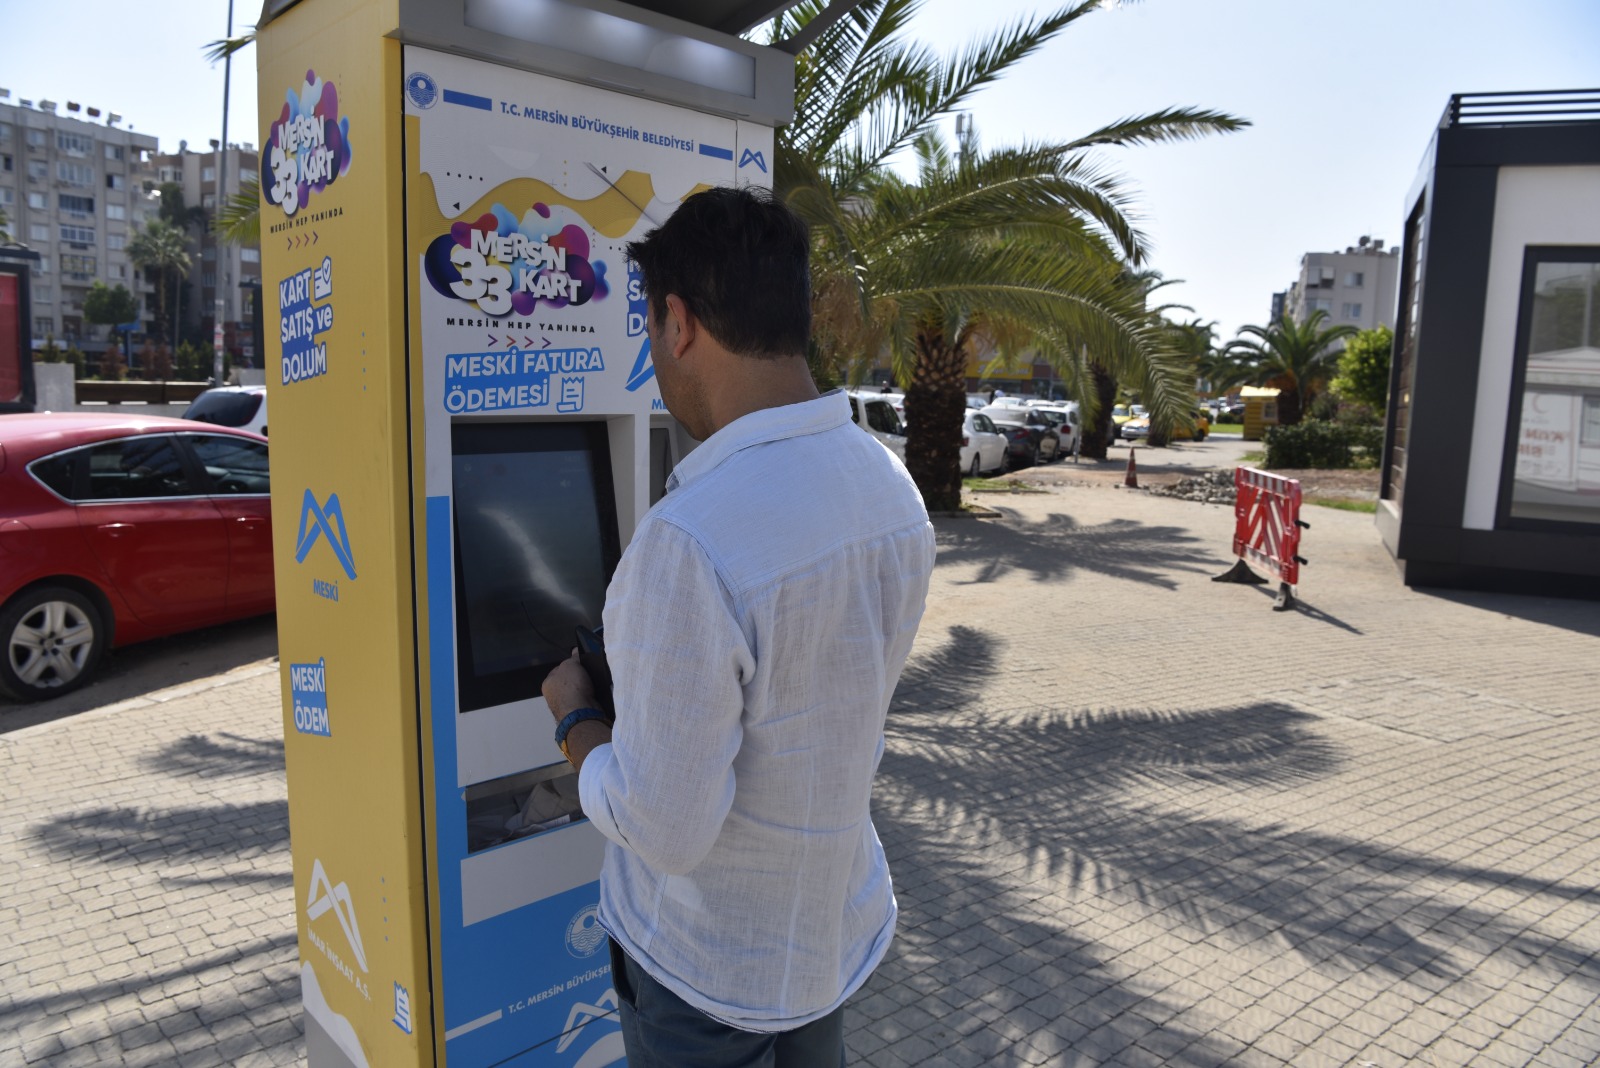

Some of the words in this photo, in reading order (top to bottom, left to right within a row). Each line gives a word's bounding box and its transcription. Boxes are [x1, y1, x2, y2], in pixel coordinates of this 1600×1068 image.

[278, 105, 325, 154] MERSİN
[500, 101, 521, 117] T.C.
[524, 106, 568, 126] MERSİN
[571, 115, 640, 141] BÜYÜKŞEHİR
[642, 132, 694, 152] BELEDİYESİ
[270, 146, 299, 215] 33
[300, 149, 334, 186] KART
[295, 215, 309, 227] HEP
[311, 206, 343, 222] YANINDA
[470, 229, 566, 271] MERSİN
[280, 270, 311, 309] KART
[450, 248, 513, 316] 33
[519, 268, 582, 302] KART
[281, 306, 314, 344] SATIŞ
[316, 306, 332, 330] ve
[446, 317, 499, 328] MERSİN
[508, 321, 531, 330] HEP
[539, 323, 595, 333] YANINDA
[282, 344, 326, 383] DOLUM
[448, 350, 517, 378] MESKİ
[523, 348, 603, 374] FATURA
[447, 379, 548, 409] ÖDEMESİ
[313, 579, 338, 602] MESKİ
[291, 661, 325, 692] MESKİ
[294, 699, 330, 733] ÖDEM
[508, 1000, 526, 1014] T.C.
[527, 984, 564, 1006] MERSİN
[566, 963, 612, 990] BÜYÜKŞE
